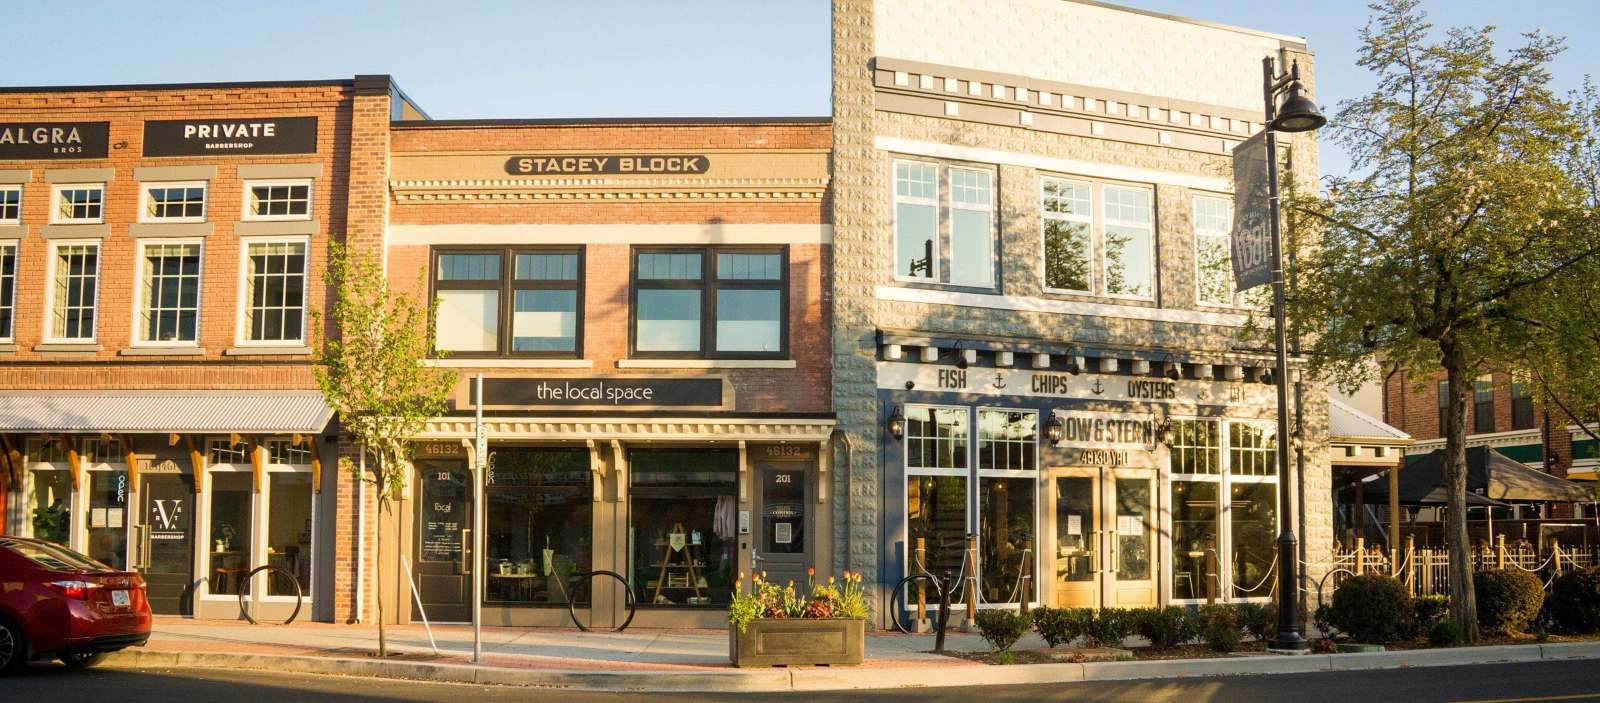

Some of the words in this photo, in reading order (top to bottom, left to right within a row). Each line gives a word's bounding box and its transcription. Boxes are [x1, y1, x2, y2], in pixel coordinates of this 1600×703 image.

[0, 127, 82, 144] ALGRA
[184, 123, 275, 138] PRIVATE
[518, 158, 608, 172] STACEY
[619, 158, 699, 172] BLOCK
[938, 368, 967, 389] FISH
[1031, 374, 1068, 395] CHIPS
[1128, 380, 1176, 399] OYSTERS
[537, 382, 563, 400] the
[565, 382, 603, 400] local
[606, 387, 653, 405] space
[1094, 418, 1105, 441] &
[1106, 419, 1152, 444] STERN
[425, 444, 459, 454] 46132
[766, 446, 801, 456] 46132
[437, 471, 451, 481] 101
[775, 474, 792, 483] 201
